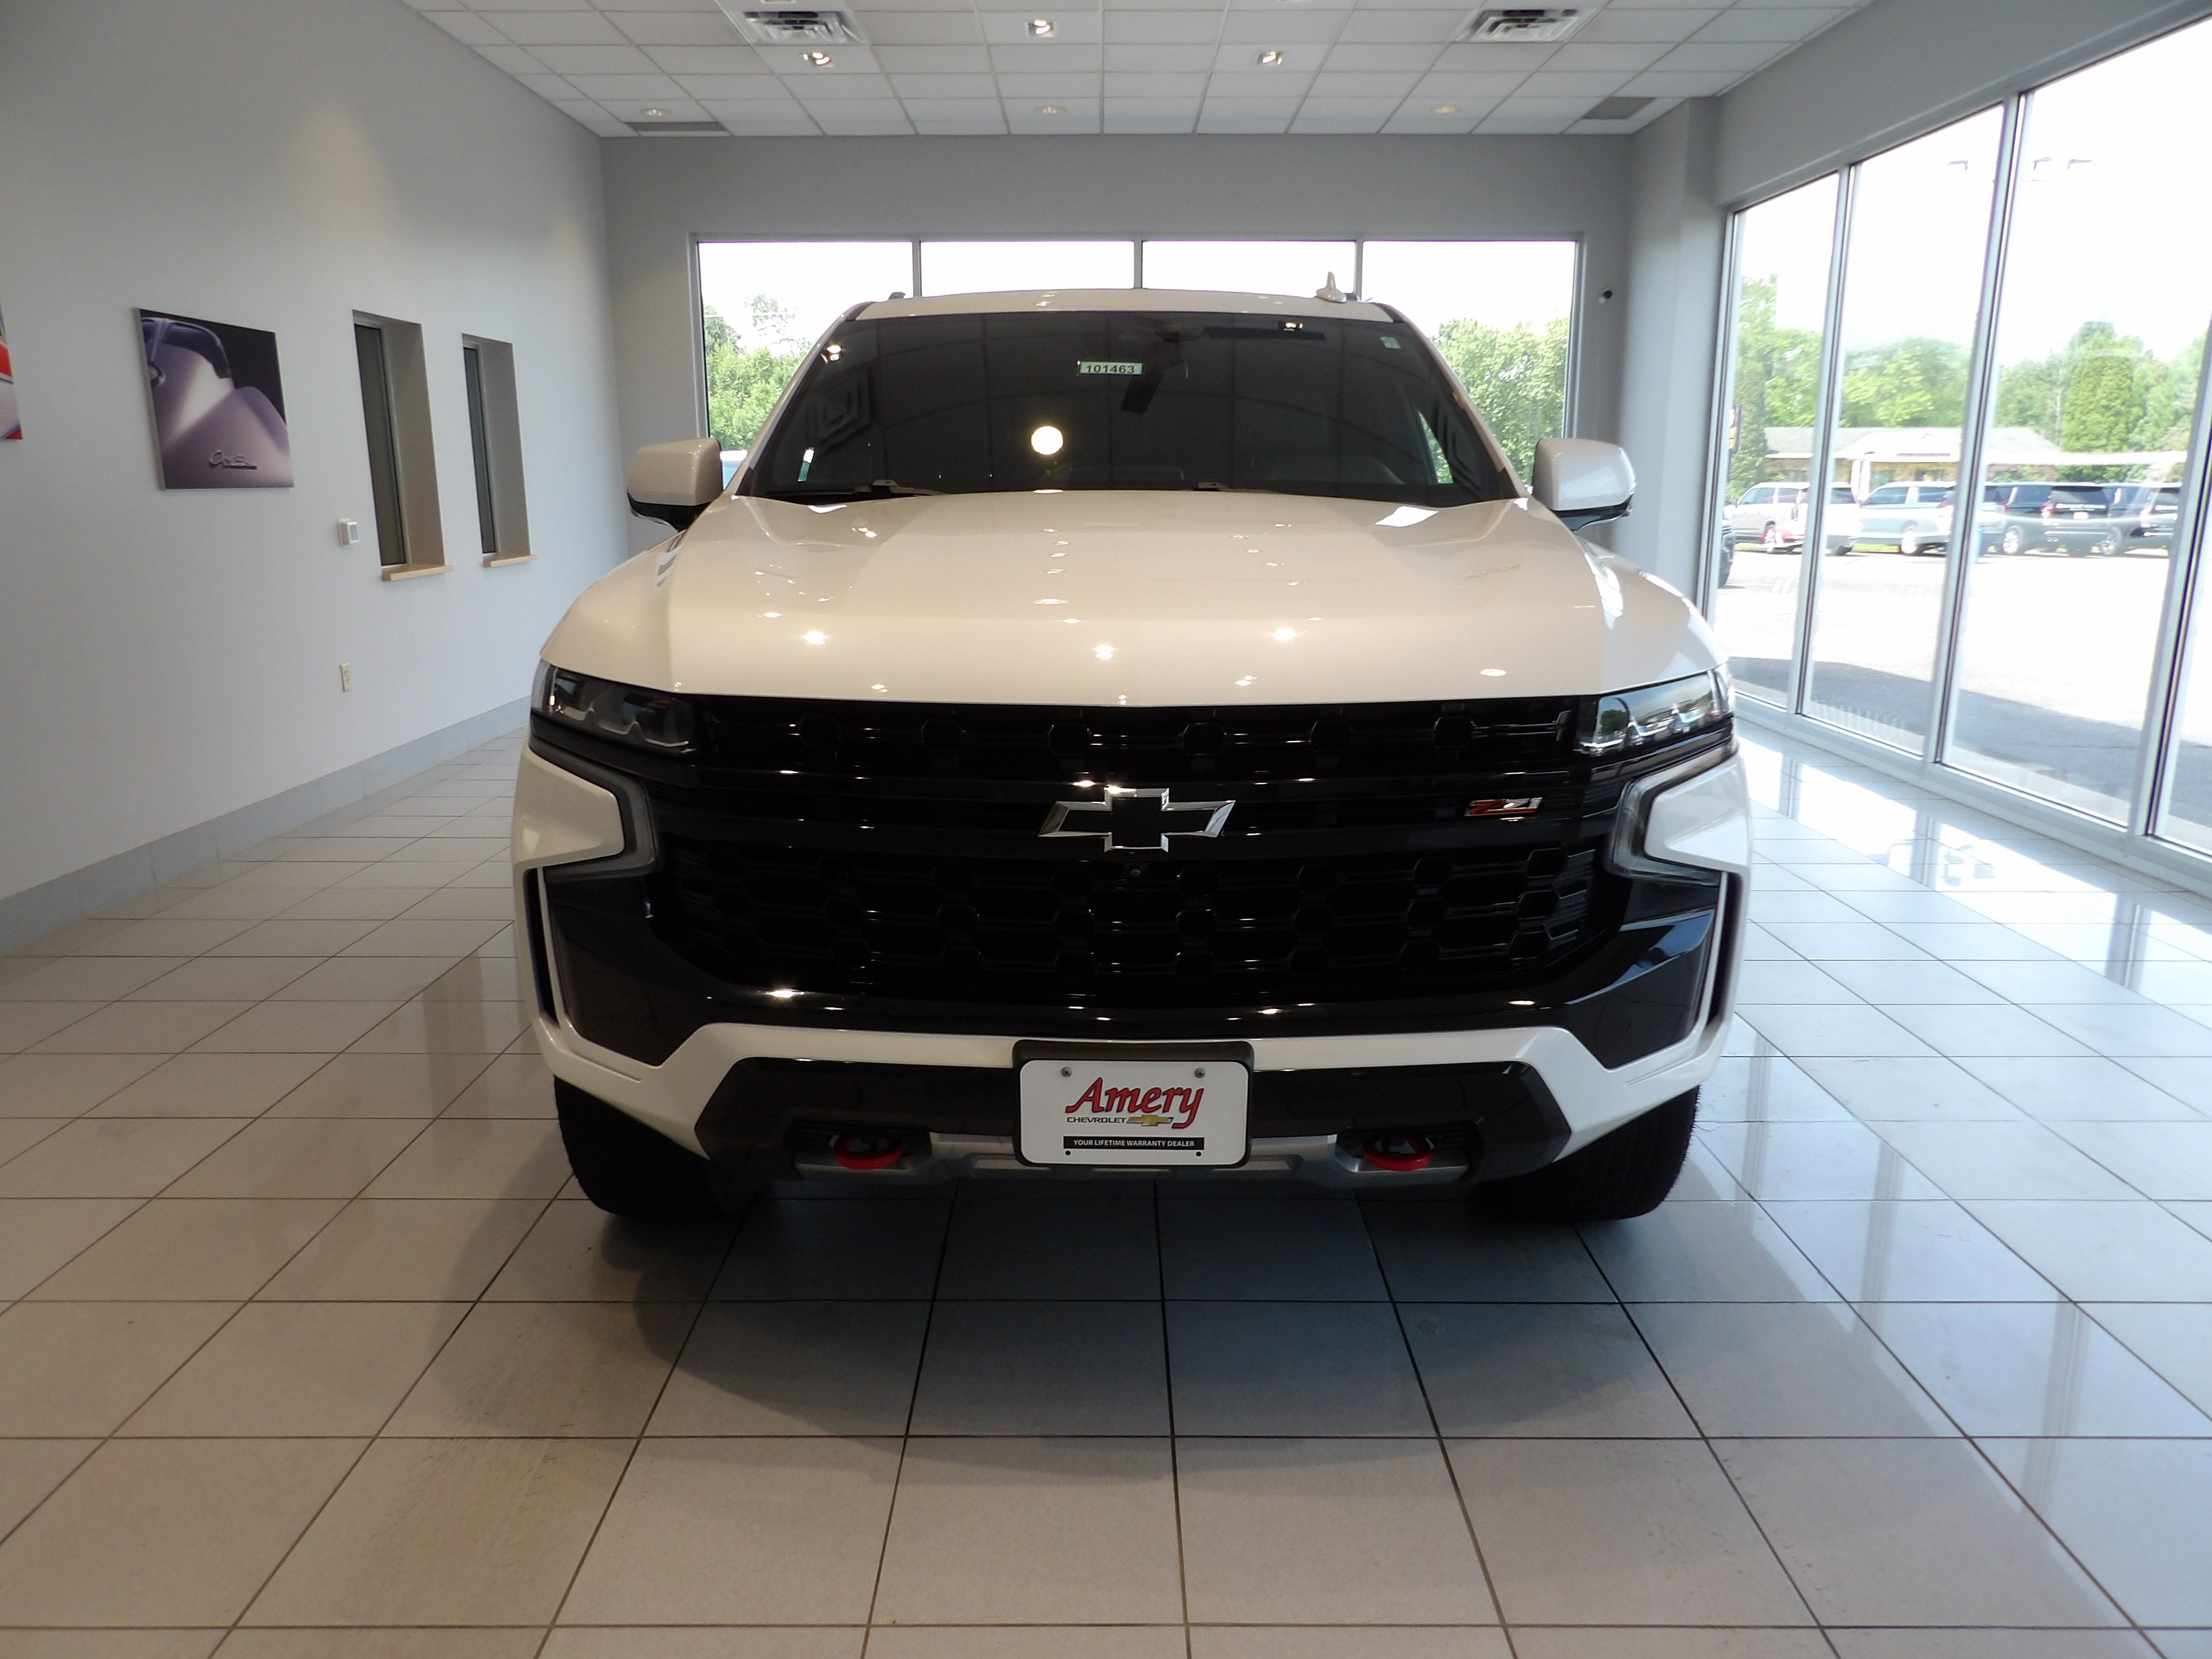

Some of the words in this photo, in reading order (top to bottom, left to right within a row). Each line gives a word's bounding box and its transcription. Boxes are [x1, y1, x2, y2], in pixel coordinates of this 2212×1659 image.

[1086, 364, 1135, 374] 101463
[1464, 797, 1542, 817] Z71
[1065, 1076, 1204, 1129] Amery
